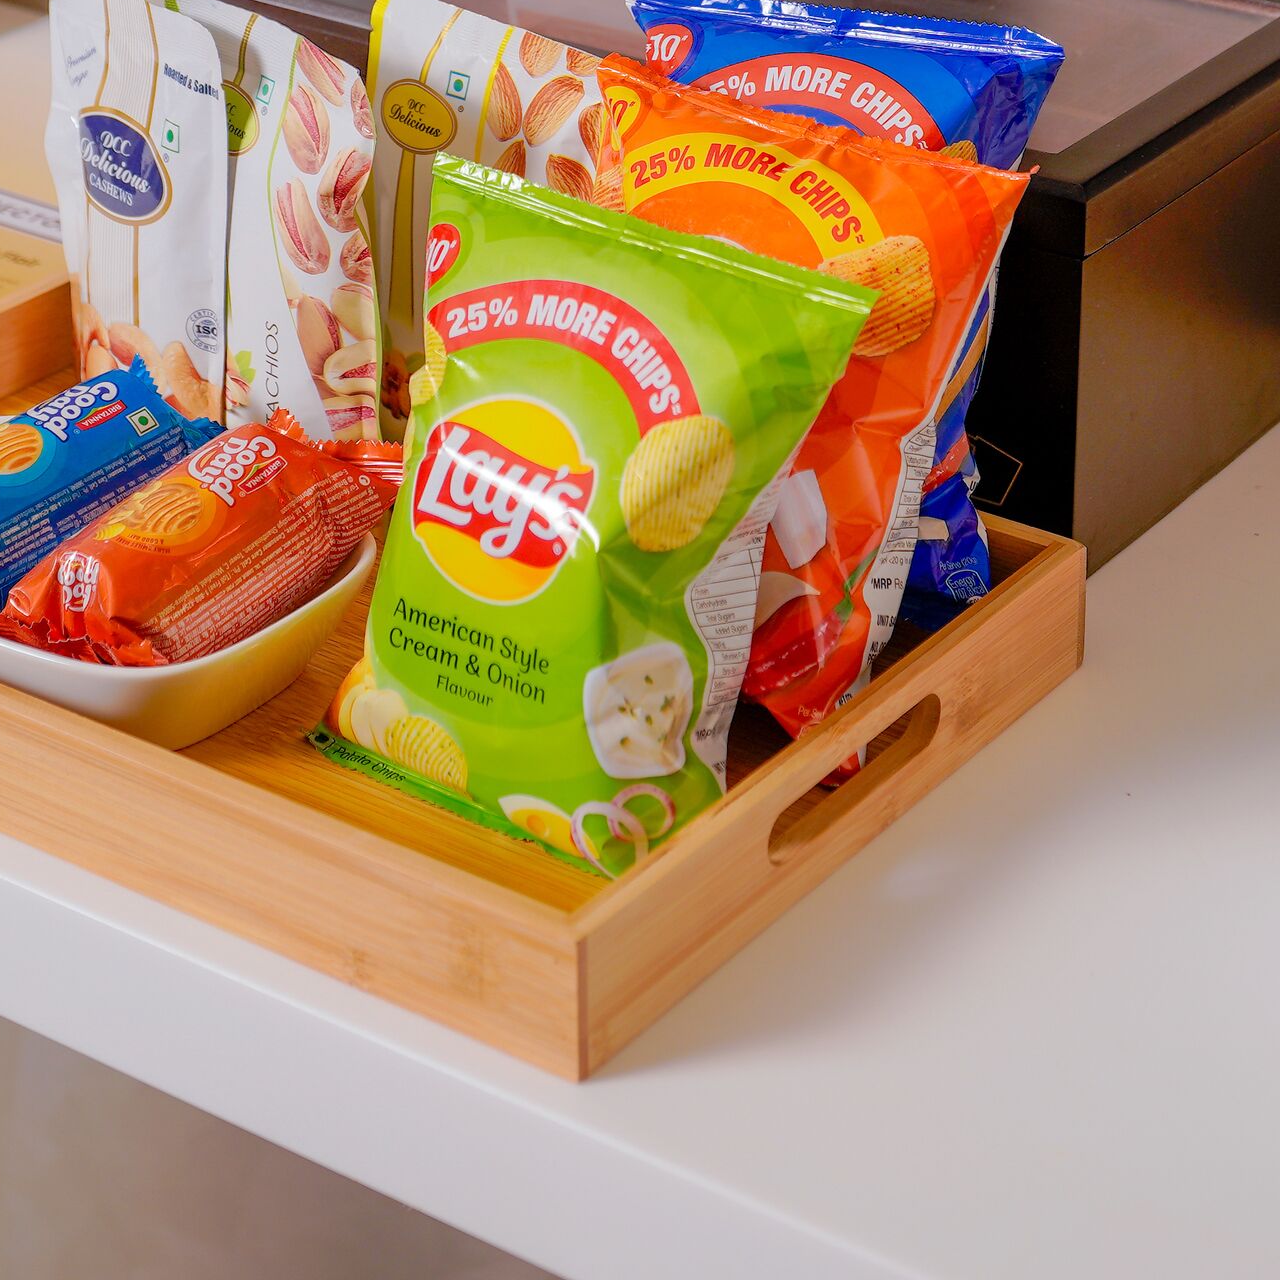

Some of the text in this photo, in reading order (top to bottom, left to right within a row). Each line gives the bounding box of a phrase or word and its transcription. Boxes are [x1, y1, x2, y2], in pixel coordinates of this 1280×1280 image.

[164, 63, 187, 87] Roasted
[388, 103, 442, 138] Delicious
[709, 66, 925, 149] 5% MORE CHIPS
[81, 137, 151, 194] Delicious
[100, 130, 132, 158] DCC
[89, 173, 134, 207] CASHEWS
[630, 143, 862, 243] 25% MORE CHIPS
[447, 294, 681, 414] 25% MORE CHIPS
[42, 381, 118, 442] Good
[82, 402, 122, 428] BRITANNIA
[188, 437, 248, 484] Day
[209, 435, 277, 507] Good
[245, 459, 282, 489] BRITANNIA
[417, 425, 584, 558] Lay's
[393, 598, 549, 675] American Style
[389, 627, 546, 704] Cream & Onion
[436, 674, 494, 707] Flavour
[333, 746, 406, 782] Potato Chips
